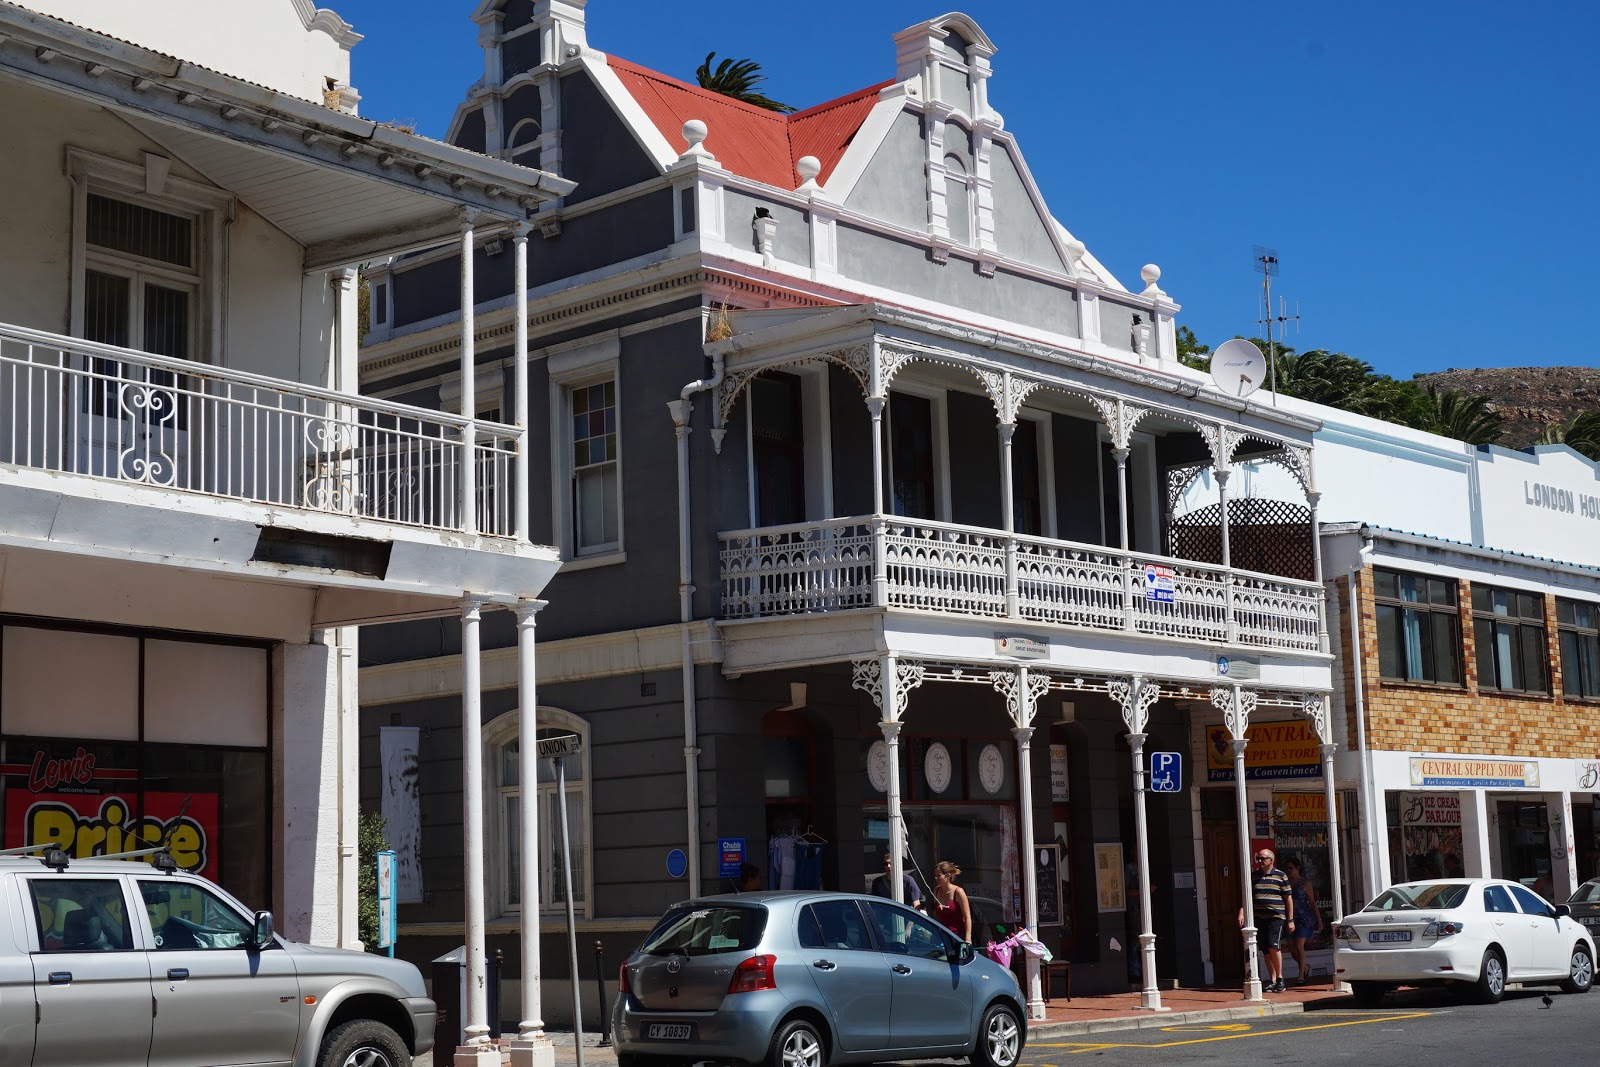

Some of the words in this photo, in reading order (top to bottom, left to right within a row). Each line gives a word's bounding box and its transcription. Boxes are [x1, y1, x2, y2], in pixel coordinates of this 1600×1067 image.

[1524, 480, 1575, 514] LONDON
[1579, 493, 1600, 521] HOU
[1247, 724, 1317, 744] ENTRAL
[538, 739, 567, 755] UNION
[1244, 750, 1279, 761] UPPLY
[1281, 747, 1319, 760] STORE
[29, 747, 96, 793] Lewis
[1160, 754, 1173, 771] P
[1422, 760, 1463, 776] CENTRAL
[1464, 762, 1496, 776] SUPPLY
[1498, 763, 1525, 777] STORE
[1211, 769, 1227, 778] For
[1228, 770, 1249, 780] yr
[1254, 765, 1318, 777] Convenience!
[1288, 795, 1326, 810] CENTR
[1424, 796, 1435, 808] ICE
[1288, 811, 1315, 821] SUPPLY
[1316, 811, 1328, 821] STO
[1425, 810, 1461, 824] PARLOUR
[27, 798, 205, 870] Price
[723, 841, 742, 849] Chubb
[1275, 833, 1306, 851] lectricity
[650, 1025, 662, 1037] CY
[663, 1025, 689, 1038] 10839
